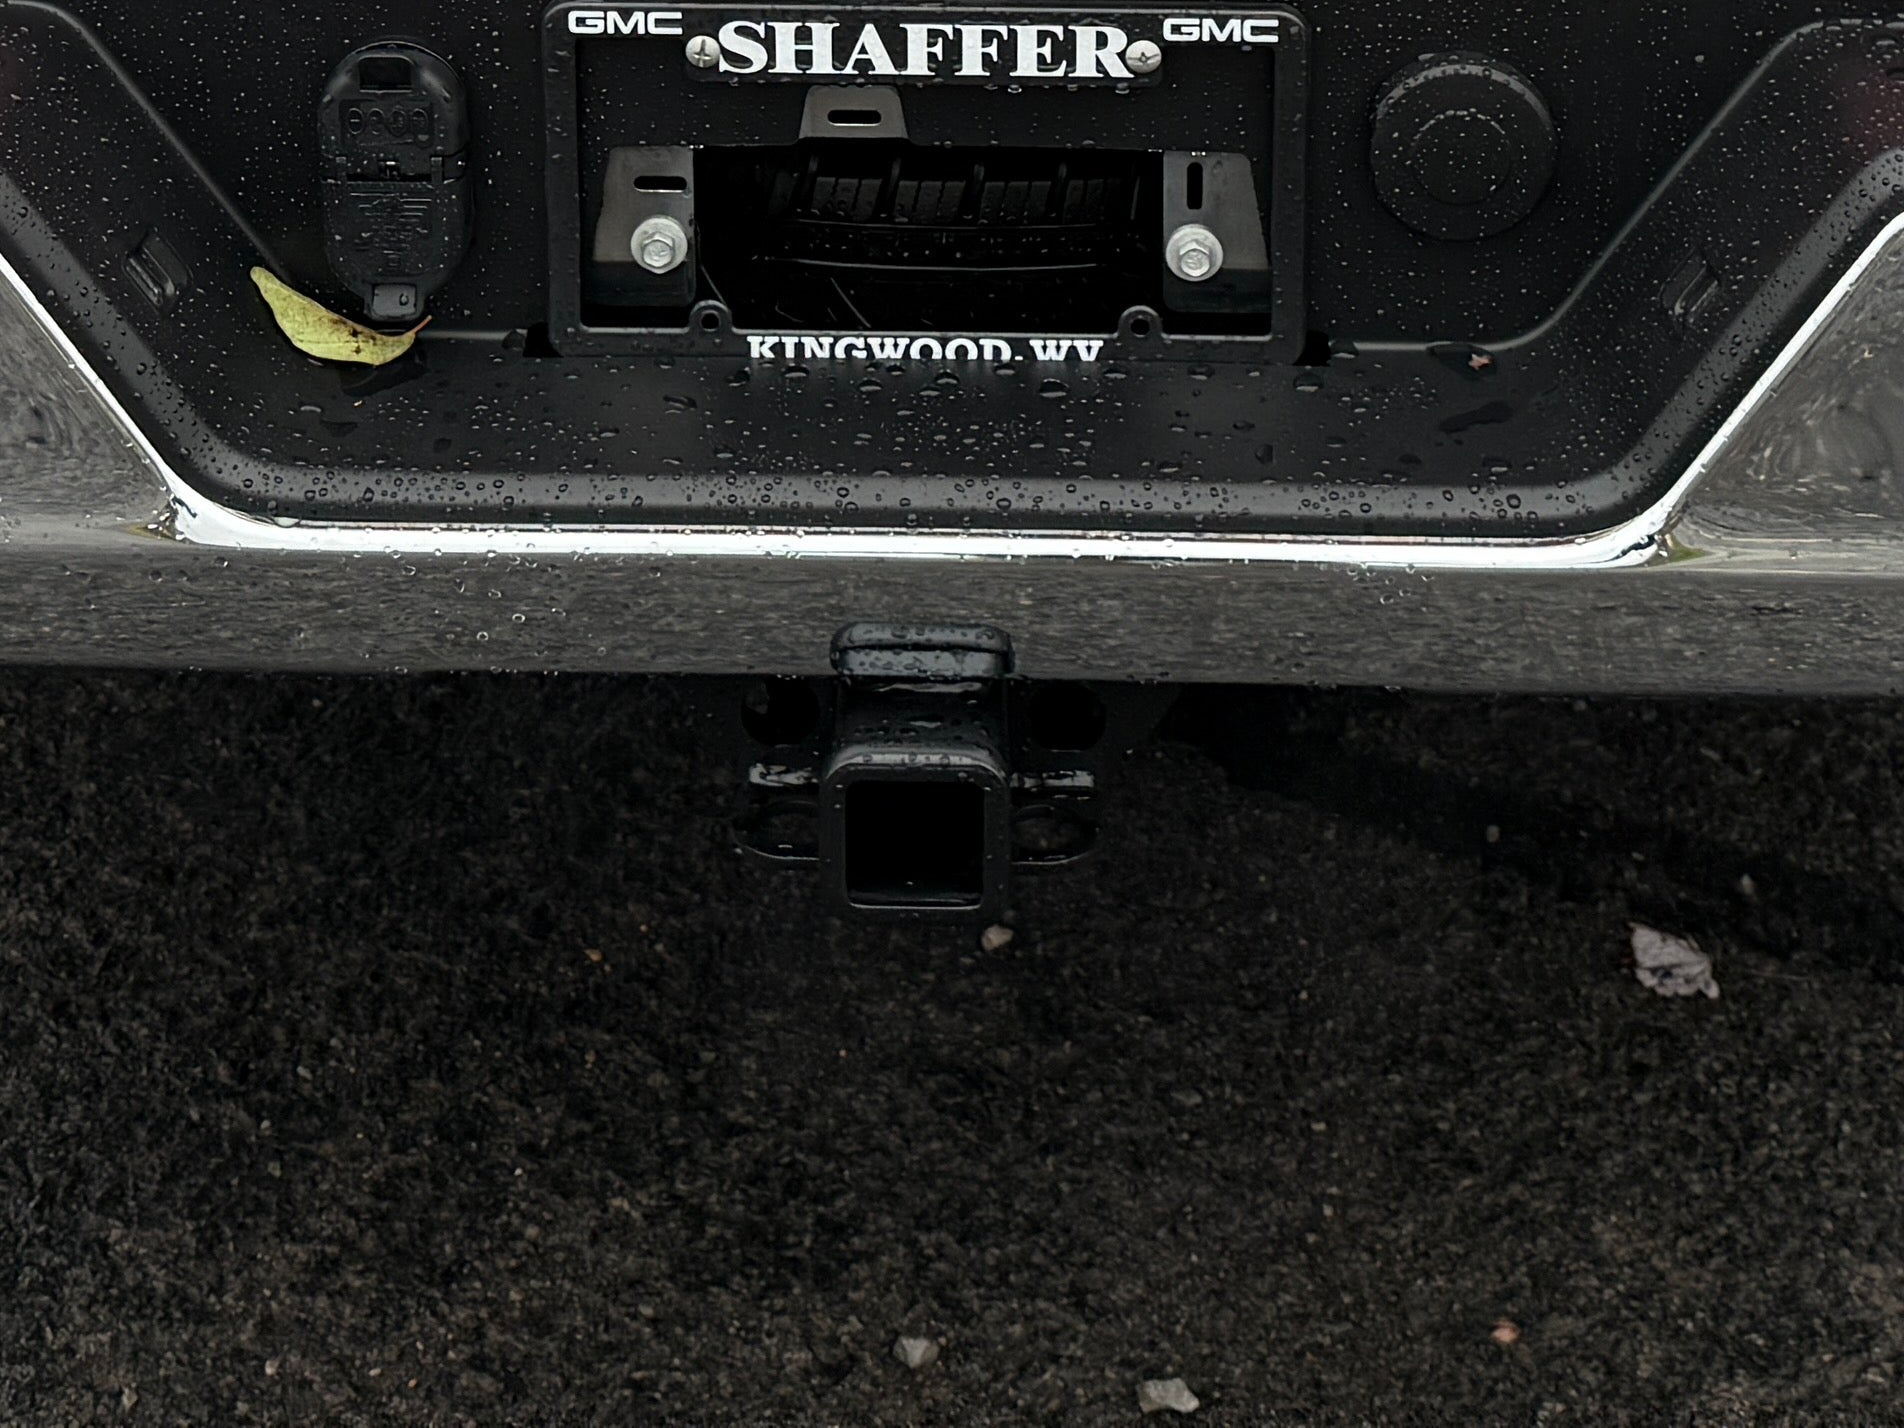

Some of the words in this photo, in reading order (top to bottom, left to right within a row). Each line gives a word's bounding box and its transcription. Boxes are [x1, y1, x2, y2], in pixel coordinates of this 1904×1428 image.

[567, 10, 683, 35] GMC
[1162, 17, 1280, 43] GMC
[717, 20, 1135, 78] SHAFFER
[1028, 339, 1104, 362] WV
